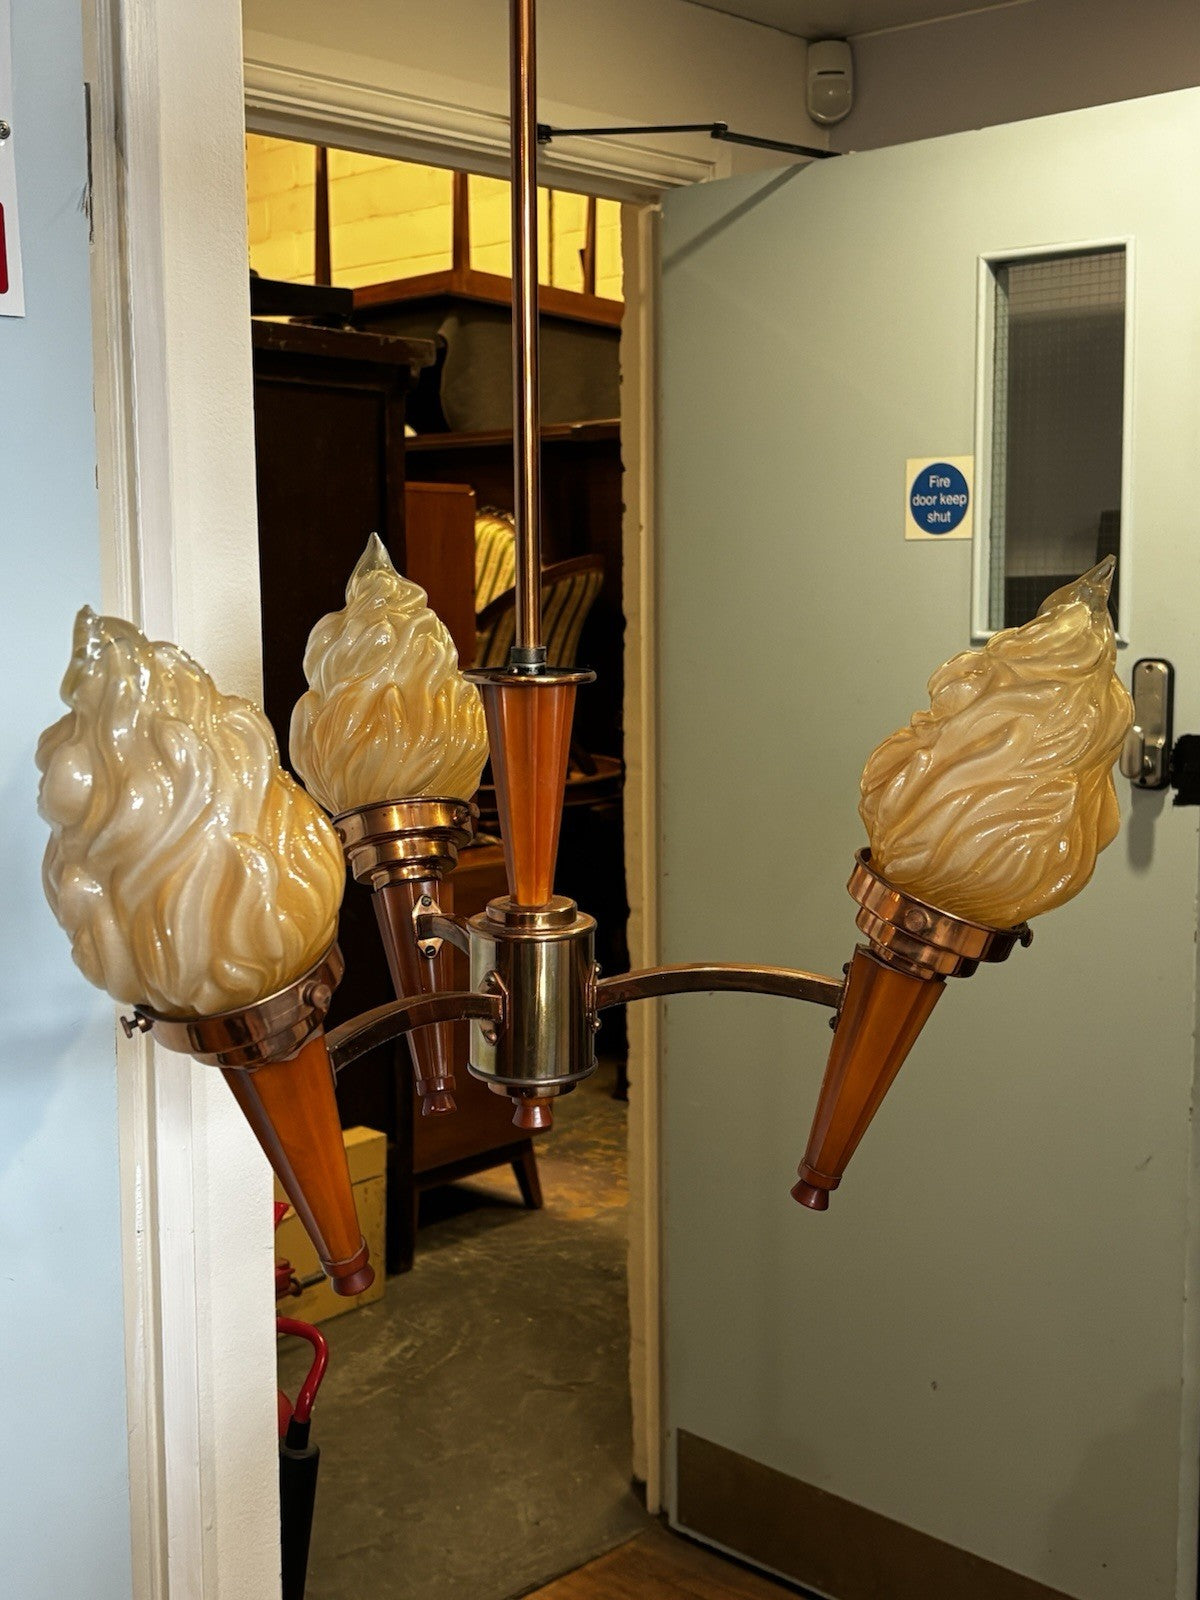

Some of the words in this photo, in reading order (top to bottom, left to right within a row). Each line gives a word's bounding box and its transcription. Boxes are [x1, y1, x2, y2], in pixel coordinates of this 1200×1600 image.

[929, 475, 951, 488] Fire
[912, 494, 937, 506] door
[940, 493, 967, 507] keep
[927, 511, 951, 523] shut
